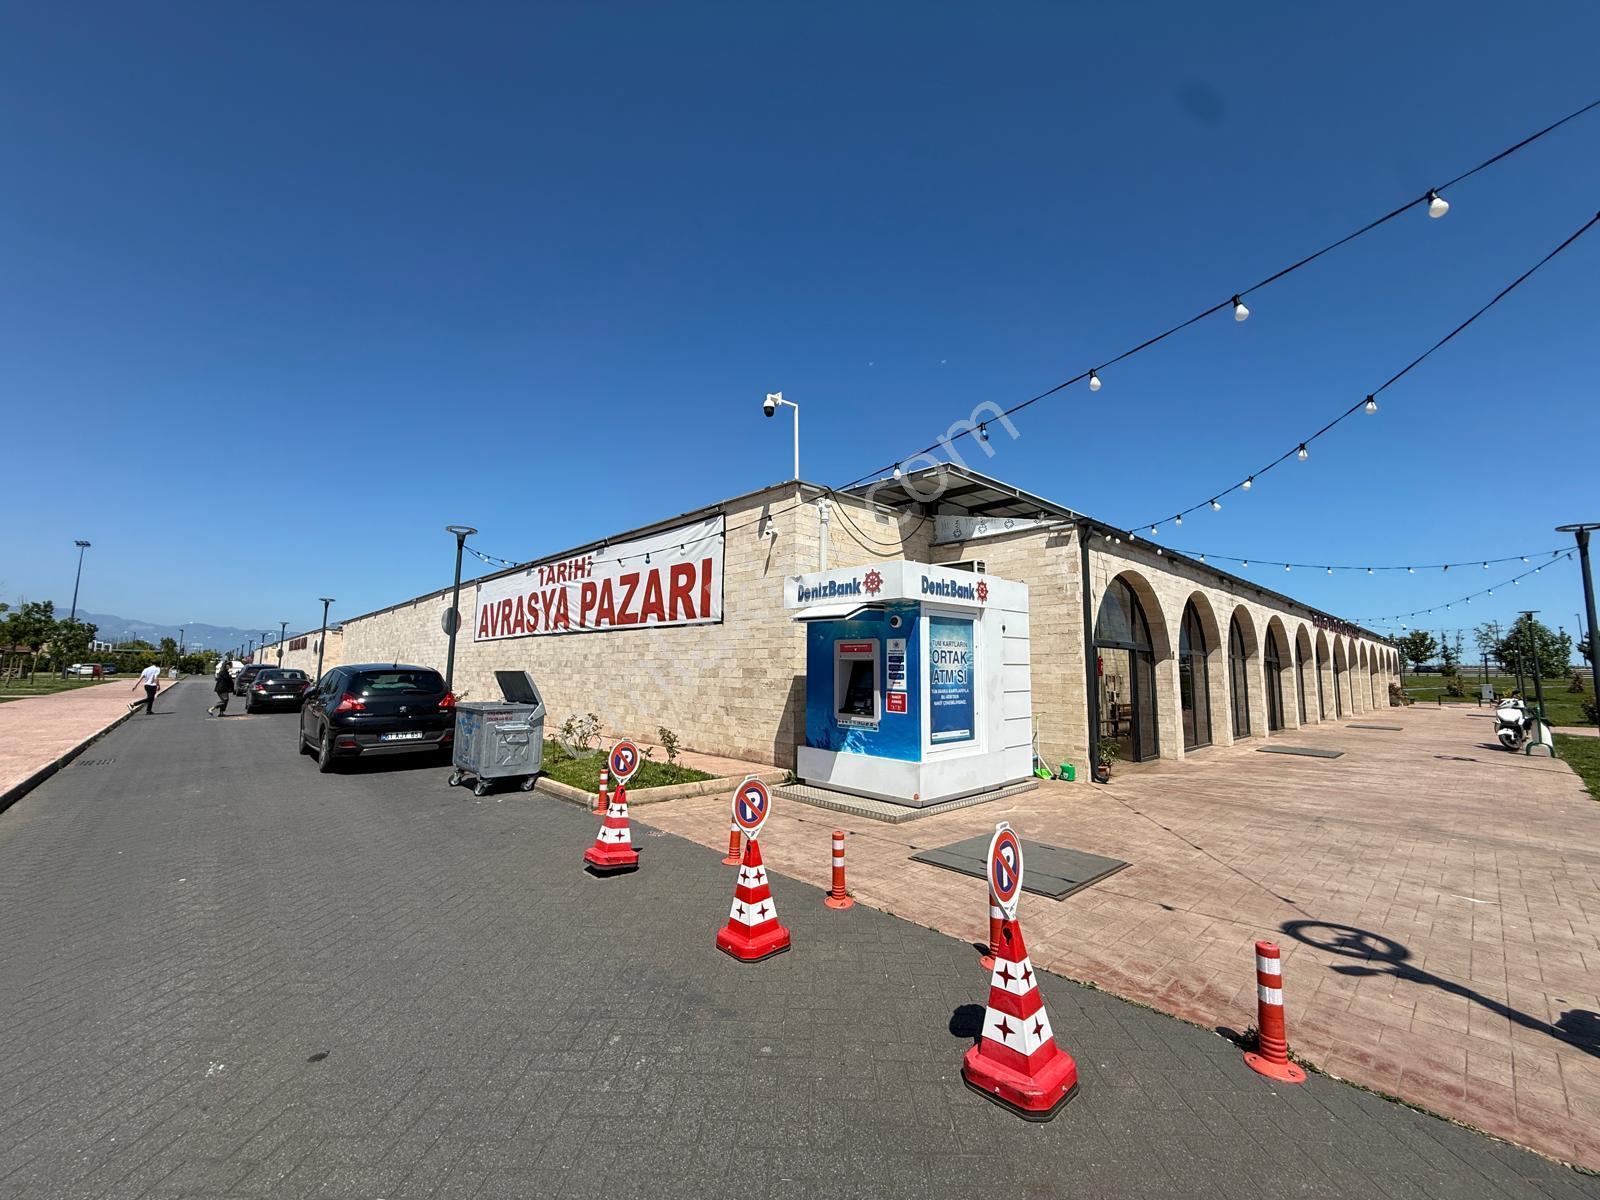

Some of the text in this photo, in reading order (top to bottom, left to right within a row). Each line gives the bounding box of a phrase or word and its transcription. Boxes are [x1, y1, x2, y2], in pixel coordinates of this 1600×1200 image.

[478, 557, 713, 639] AVRASYA PAZARI
[798, 576, 862, 603] DenizBank
[920, 574, 976, 601] DenizBank
[932, 649, 968, 665] ORTAK
